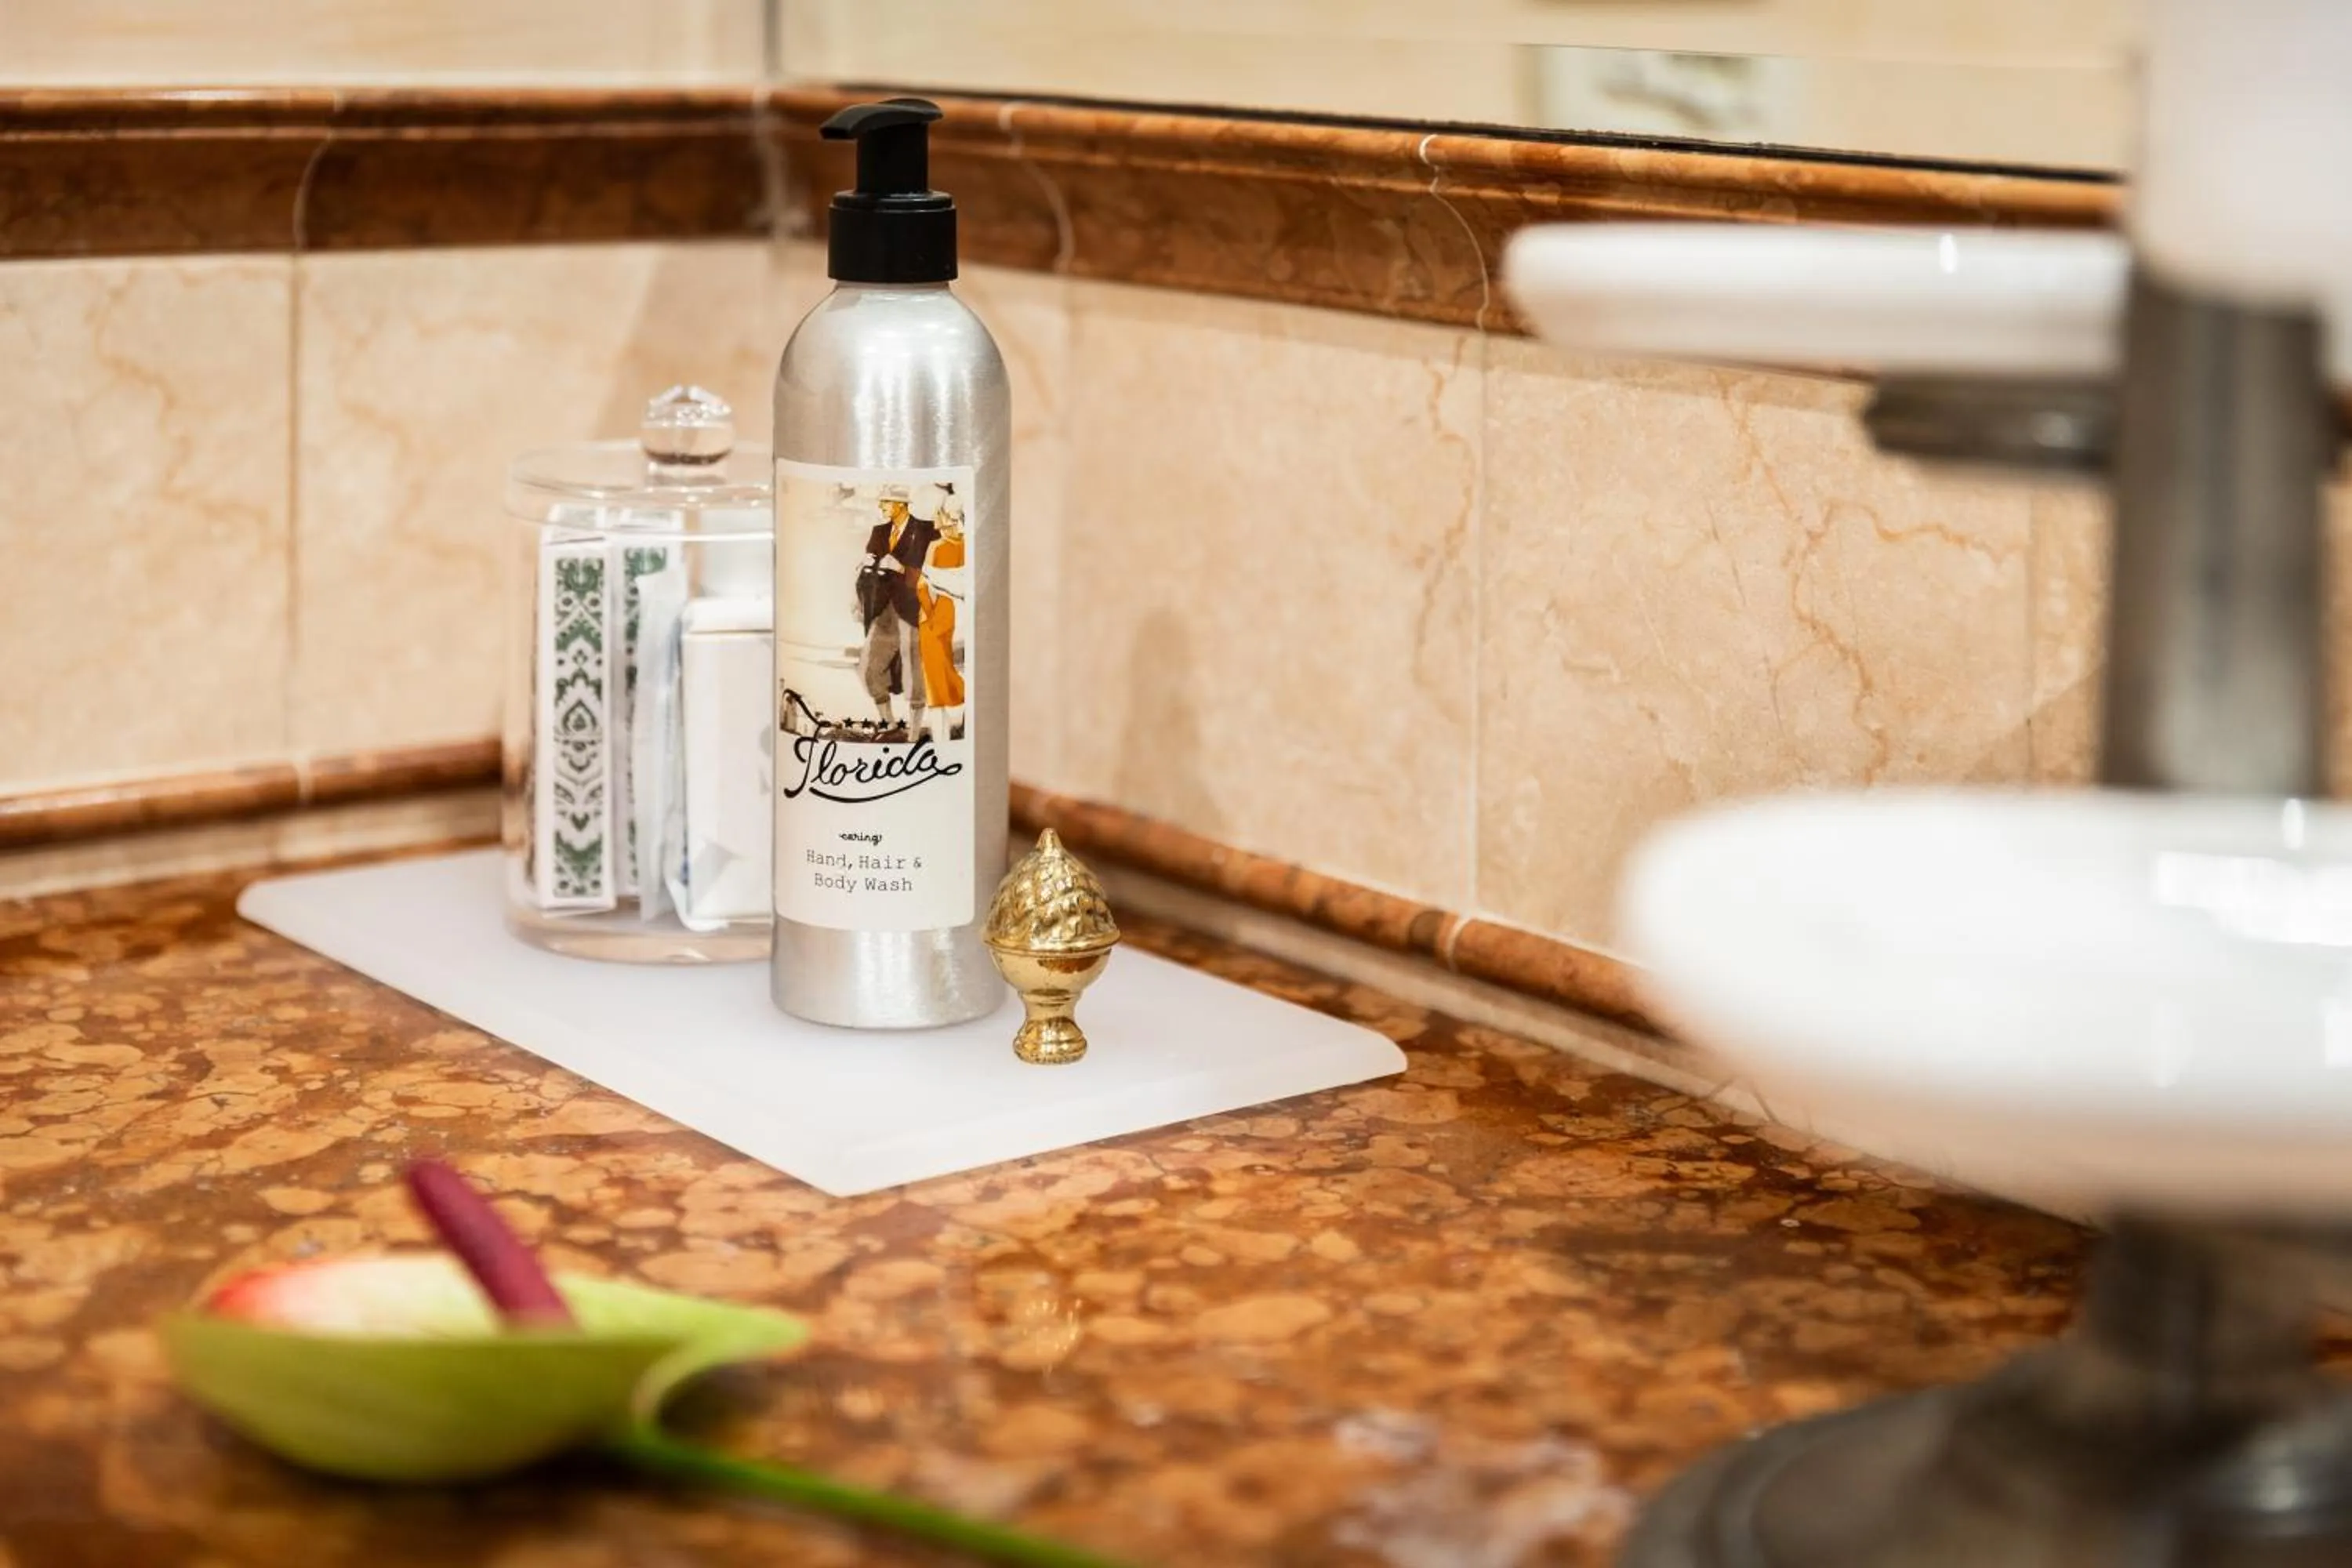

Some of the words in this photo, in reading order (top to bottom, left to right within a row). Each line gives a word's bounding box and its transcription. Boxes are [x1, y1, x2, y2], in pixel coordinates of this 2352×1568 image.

[784, 689, 963, 803] Florida
[807, 849, 853, 870] Hand,
[859, 855, 906, 869] Hair
[913, 858, 922, 868] &
[815, 873, 857, 893] Body
[865, 878, 913, 891] Wash
